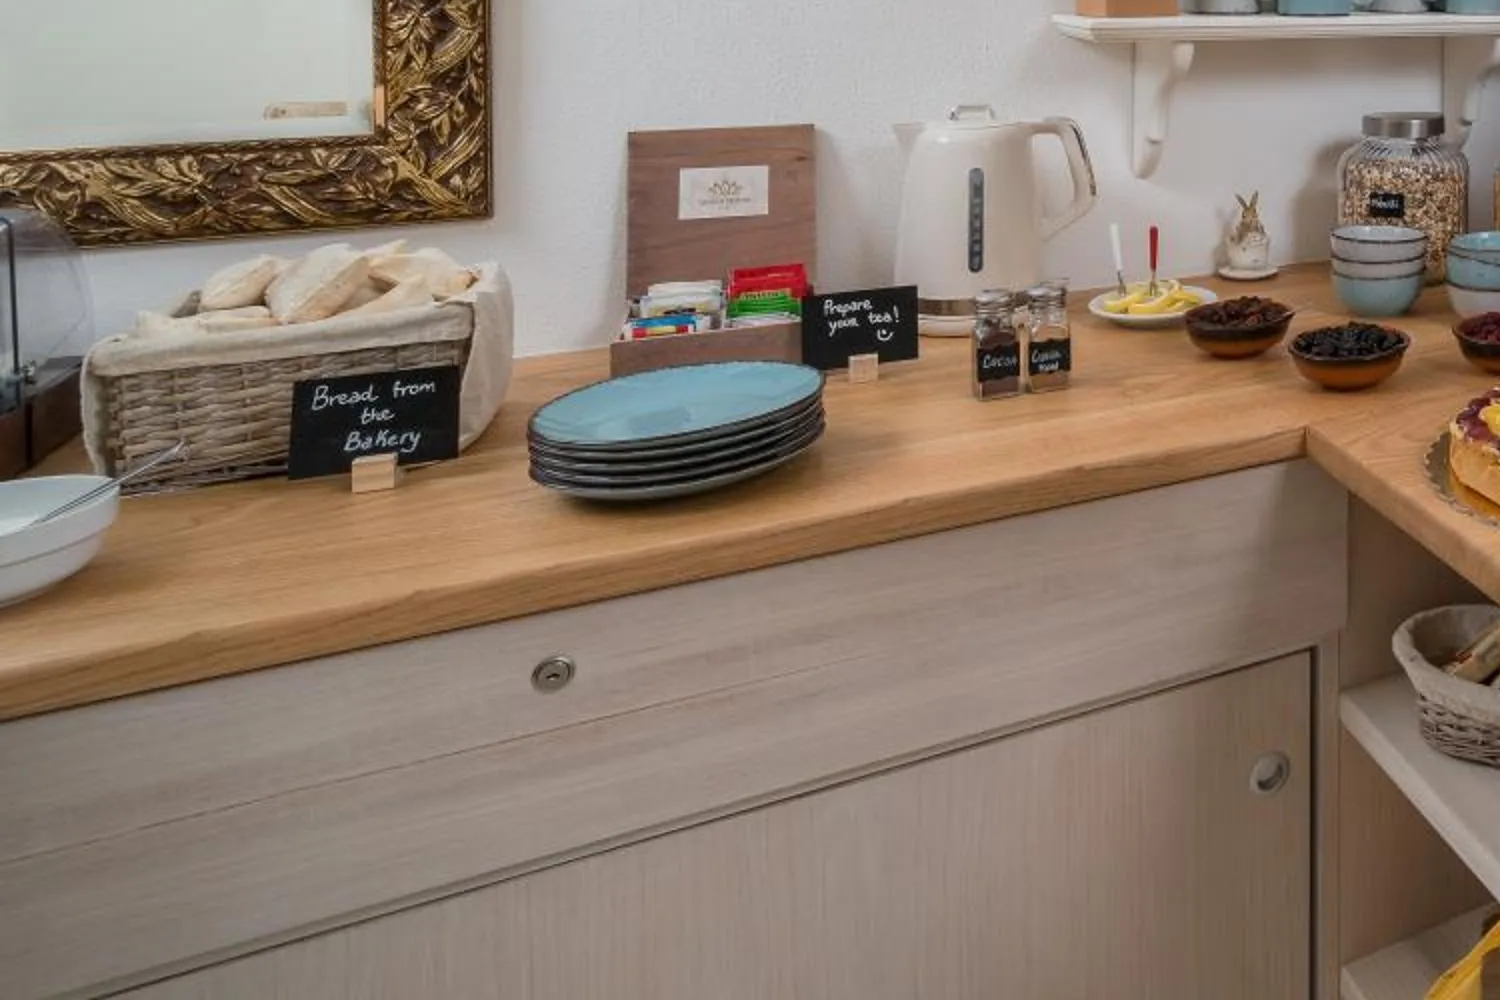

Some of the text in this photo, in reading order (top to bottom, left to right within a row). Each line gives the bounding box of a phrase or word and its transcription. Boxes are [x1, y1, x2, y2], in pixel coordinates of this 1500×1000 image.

[823, 299, 873, 318] Prepare
[311, 380, 436, 411] Bread from
[360, 407, 396, 425] the
